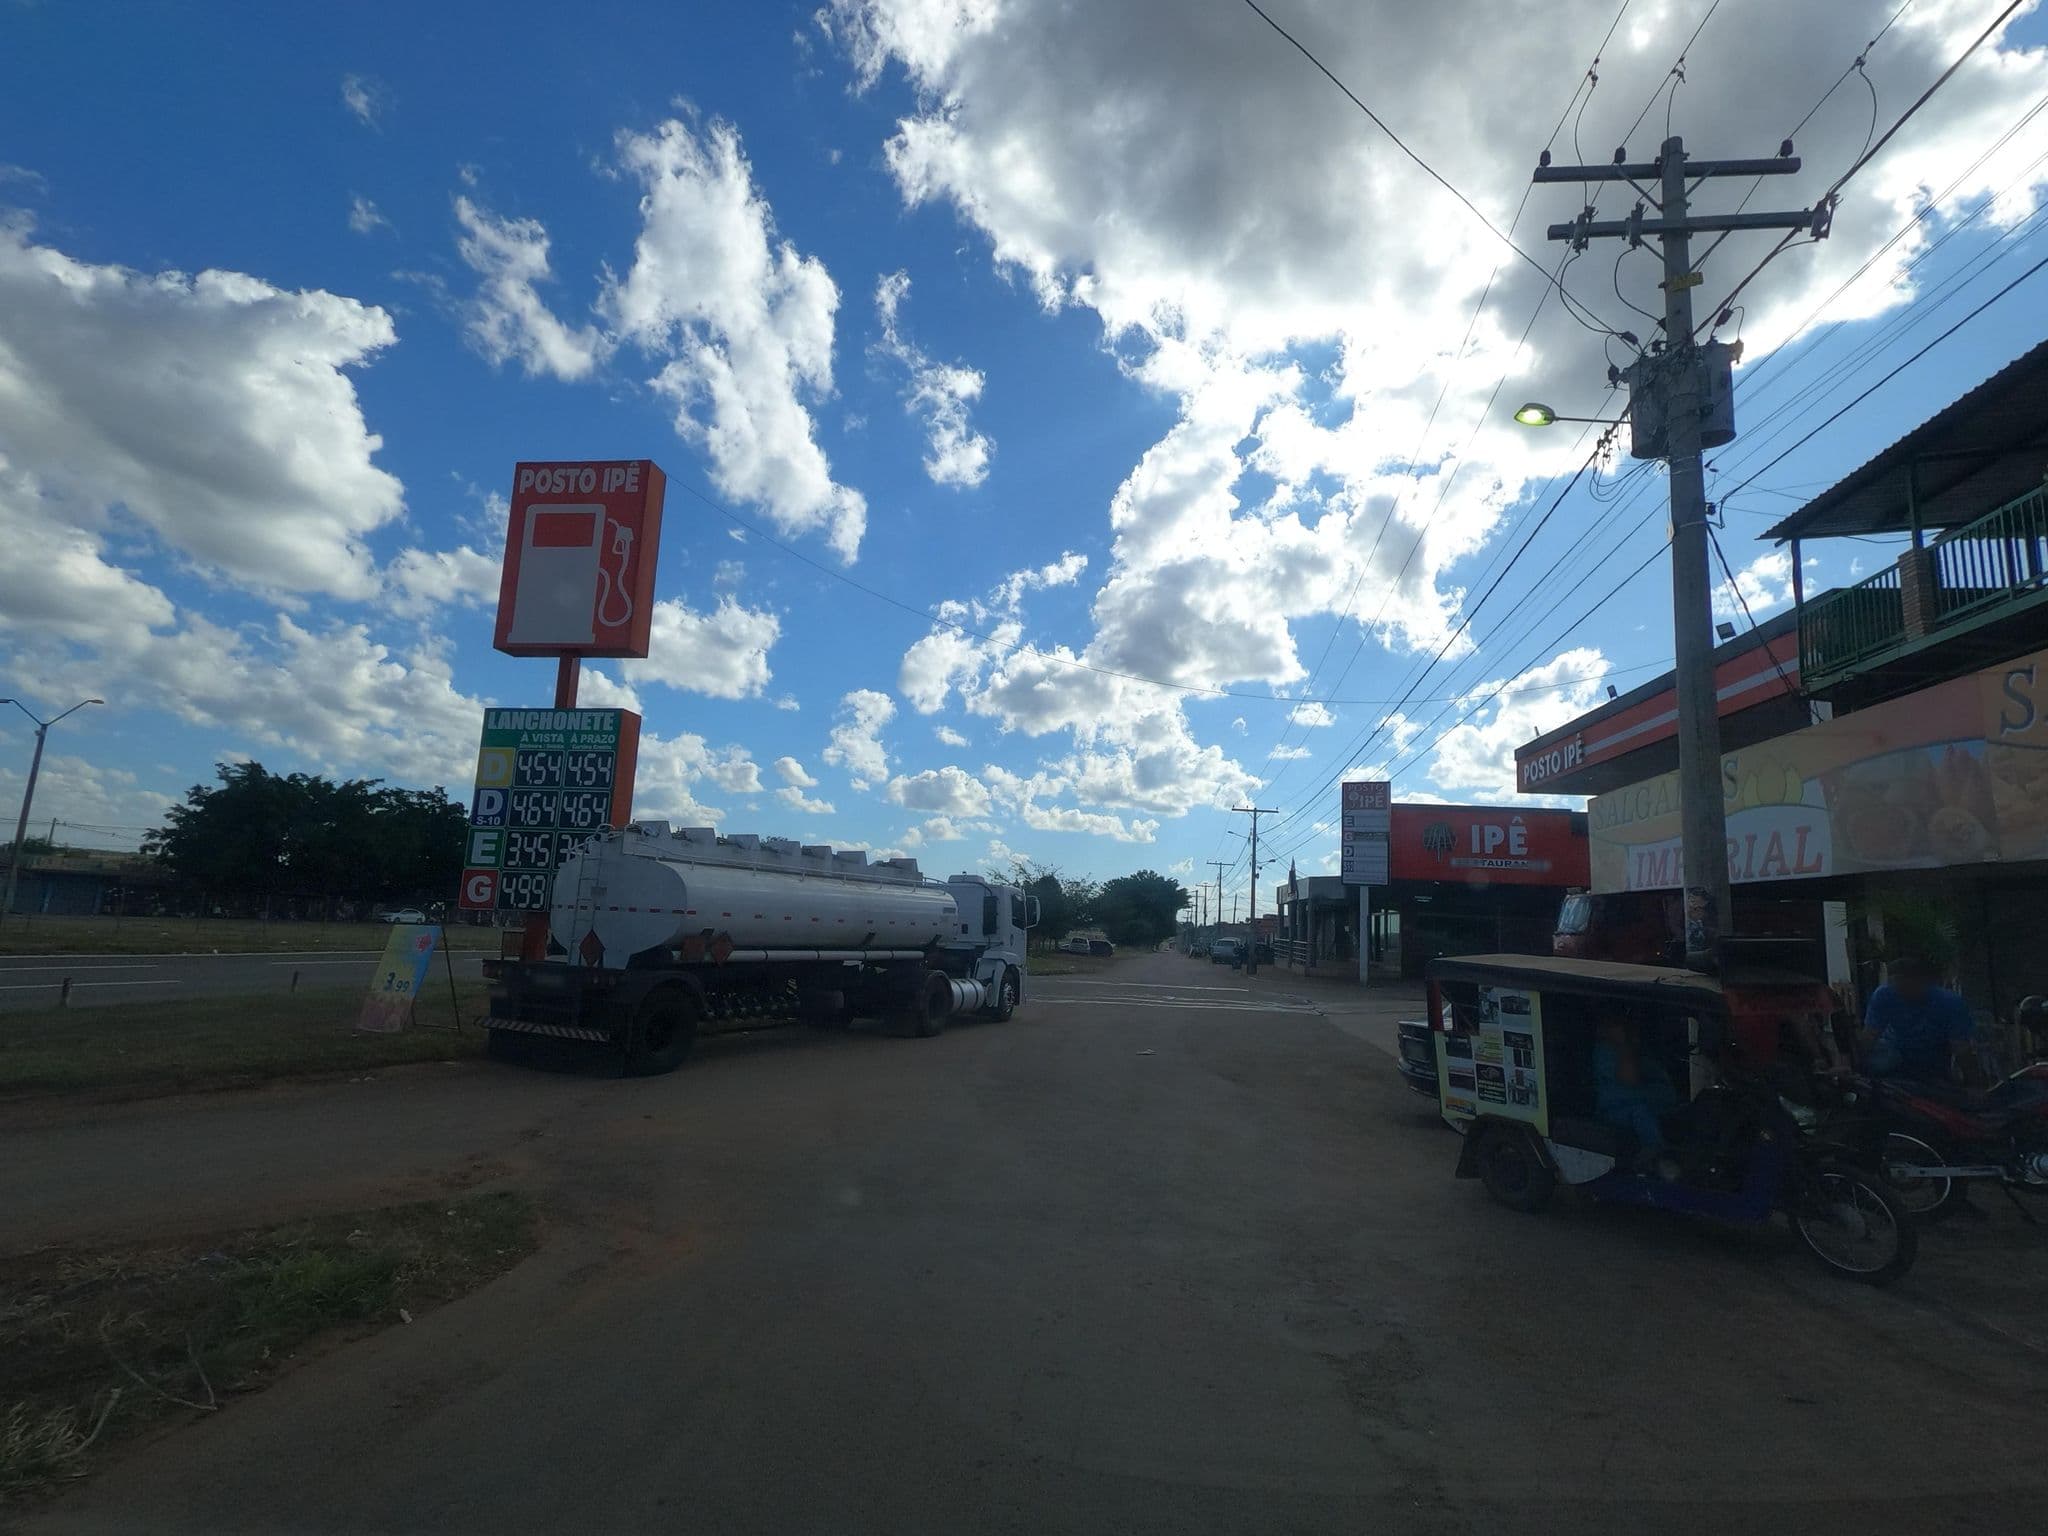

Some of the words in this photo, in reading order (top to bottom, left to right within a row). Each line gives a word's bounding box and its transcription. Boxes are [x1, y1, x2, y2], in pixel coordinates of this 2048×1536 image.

[520, 468, 596, 494] POSTO
[602, 462, 640, 493] IPÊ
[487, 711, 615, 731] LANCHONETE
[532, 733, 565, 743] VISTA
[581, 734, 616, 744] PRAZO
[482, 753, 507, 781] D
[1523, 751, 1561, 785] POSTO
[1563, 734, 1583, 770] IPÊ
[477, 789, 504, 815] D
[1593, 759, 1738, 830] SALGAS
[475, 816, 500, 826] S-10
[471, 831, 498, 864] E
[1471, 816, 1528, 855] IPÊ
[1636, 825, 1823, 888] IMPRIAL
[466, 875, 493, 903] G
